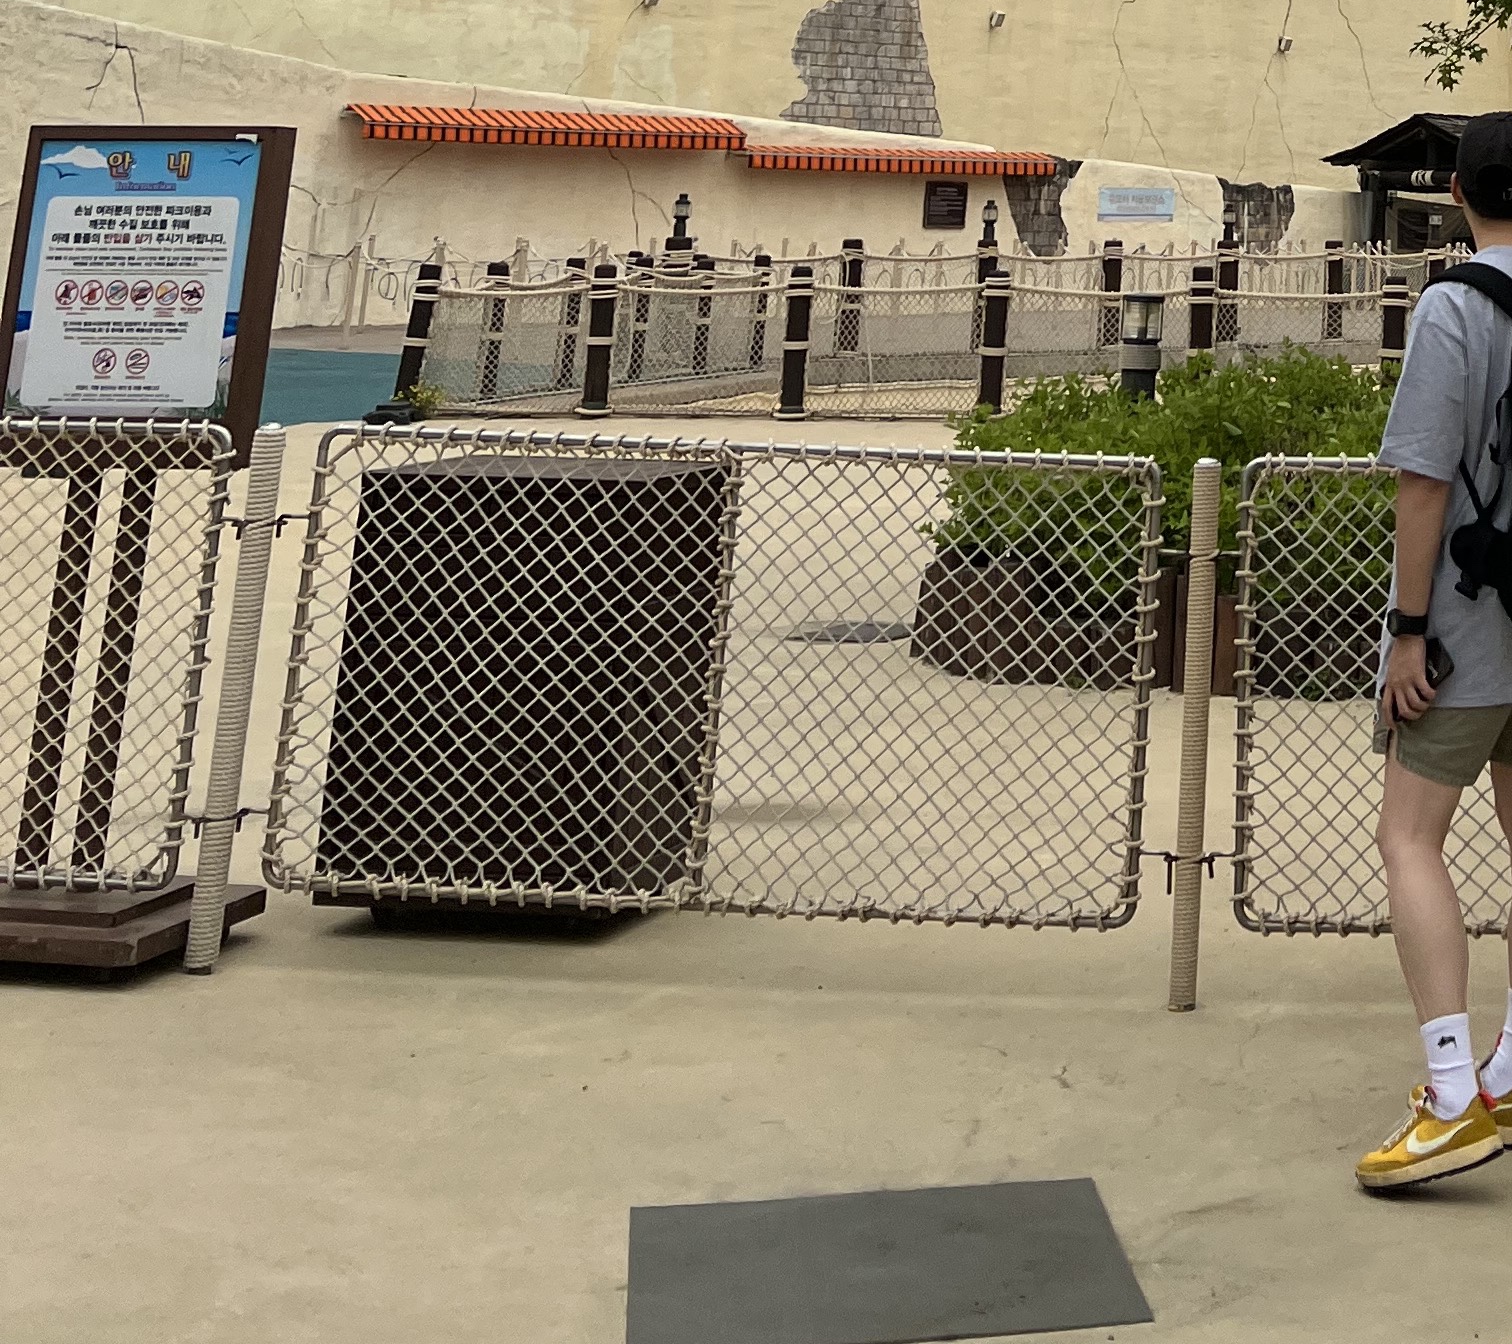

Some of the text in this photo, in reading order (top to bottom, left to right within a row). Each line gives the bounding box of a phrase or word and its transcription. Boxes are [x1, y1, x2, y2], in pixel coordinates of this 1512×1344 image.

[107, 150, 193, 181] 안 내
[155, 233, 183, 245] 주시기
